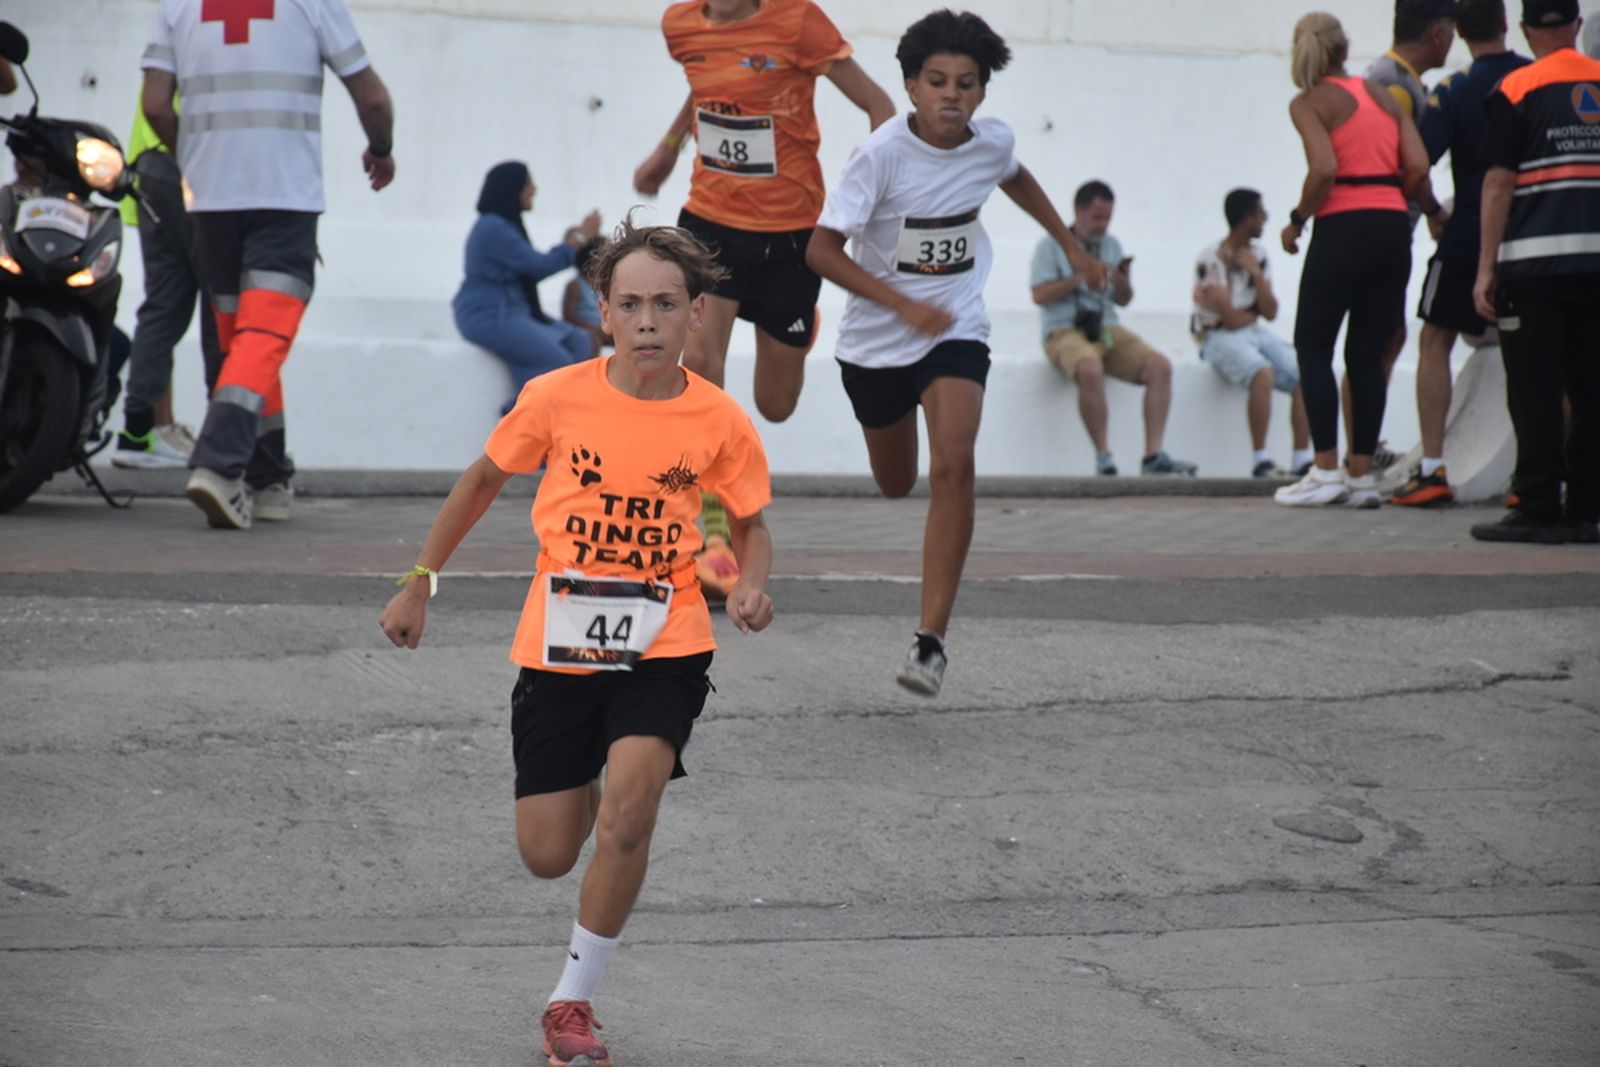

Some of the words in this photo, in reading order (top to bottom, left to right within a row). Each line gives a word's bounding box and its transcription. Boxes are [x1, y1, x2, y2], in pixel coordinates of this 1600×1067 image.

[718, 138, 749, 162] 48
[916, 236, 968, 264] 339
[599, 493, 666, 520] TRI
[566, 515, 682, 547] DINGO
[585, 614, 633, 649] 44
